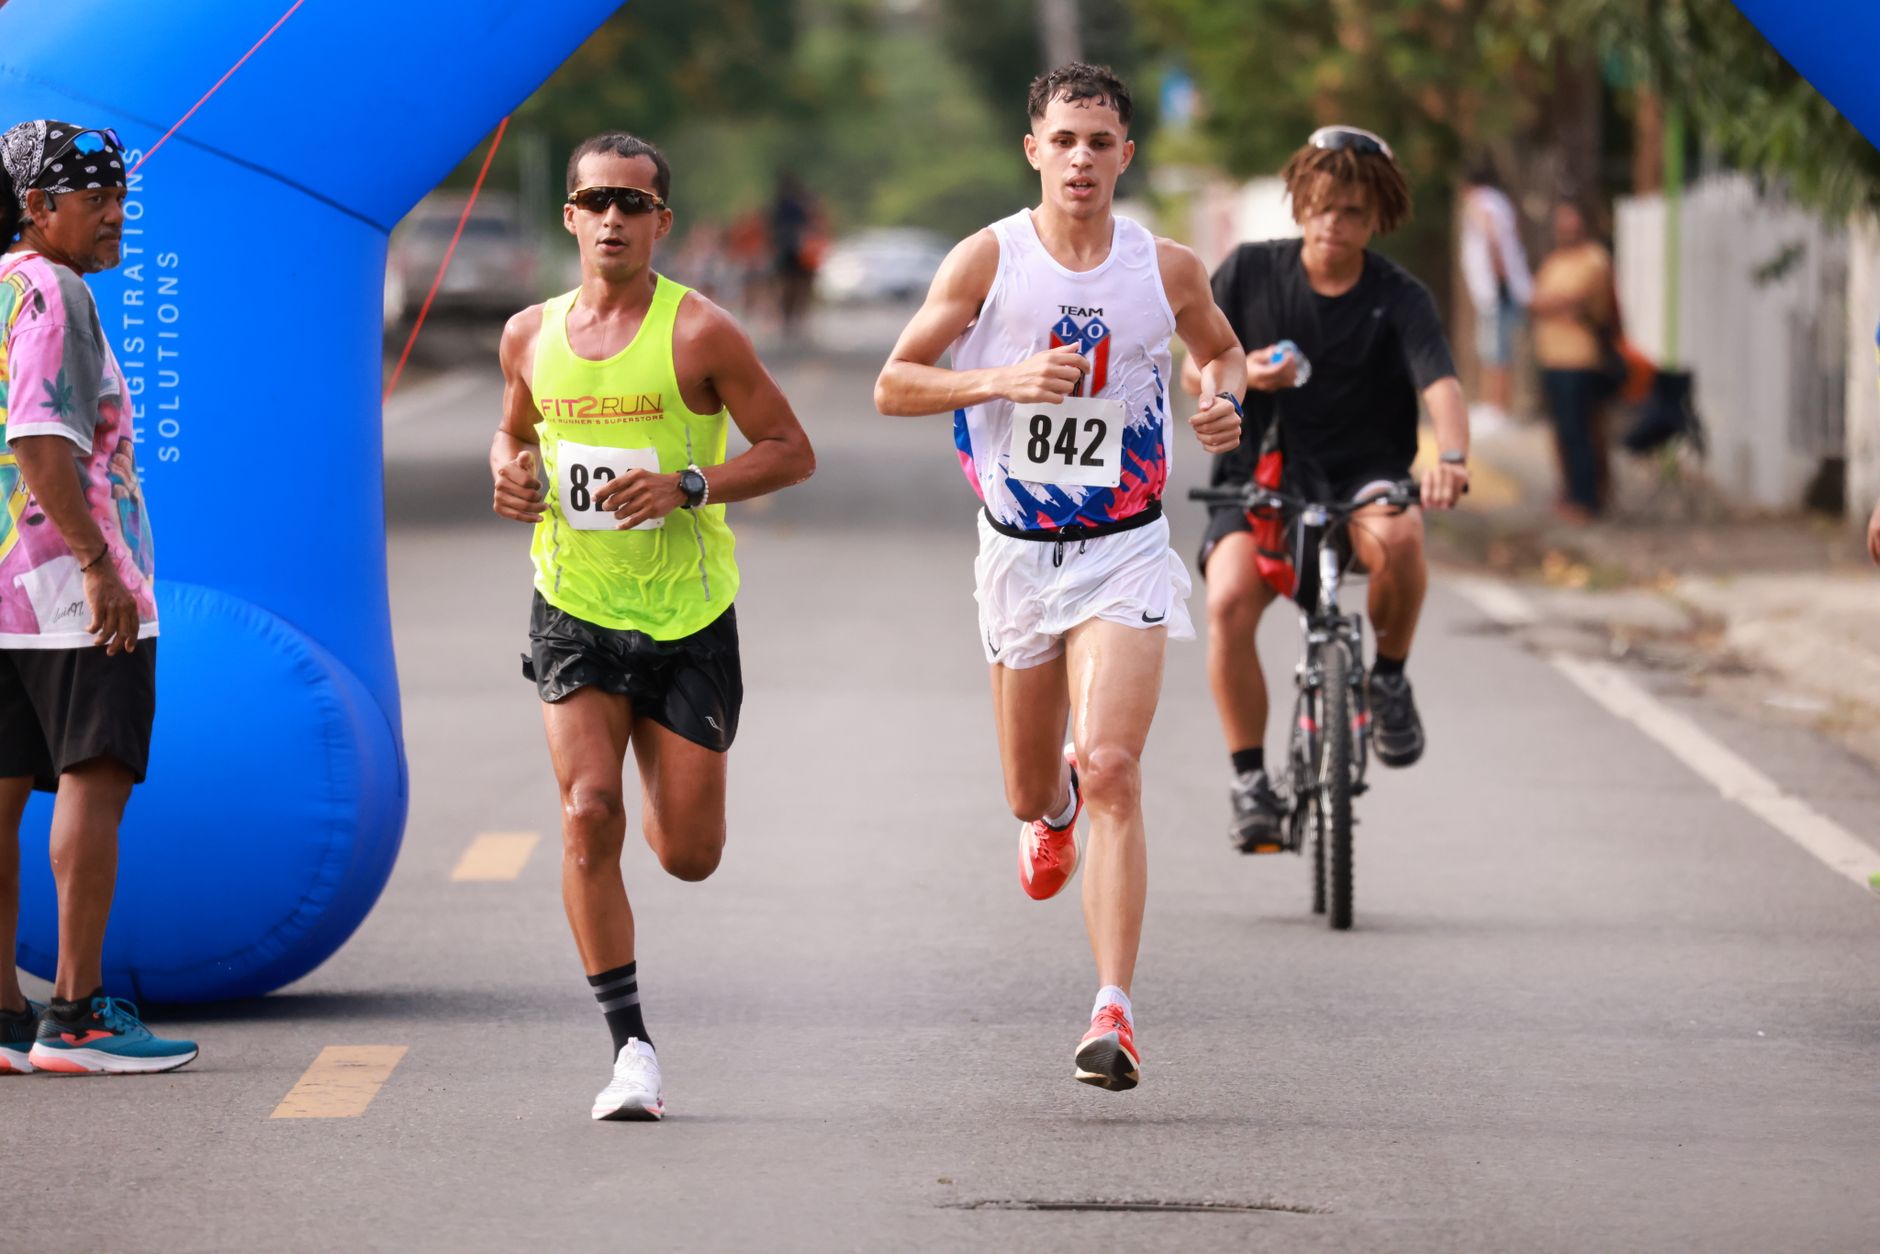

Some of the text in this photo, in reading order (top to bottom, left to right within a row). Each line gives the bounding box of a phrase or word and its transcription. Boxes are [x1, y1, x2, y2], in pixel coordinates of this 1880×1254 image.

[123, 148, 145, 444] REGISTRATIONS
[1057, 304, 1104, 318] TEAM
[157, 251, 180, 463] SOLUTIONS
[604, 414, 664, 424] SUPERSTORE
[1027, 414, 1107, 467] 842
[570, 463, 634, 512] 82
